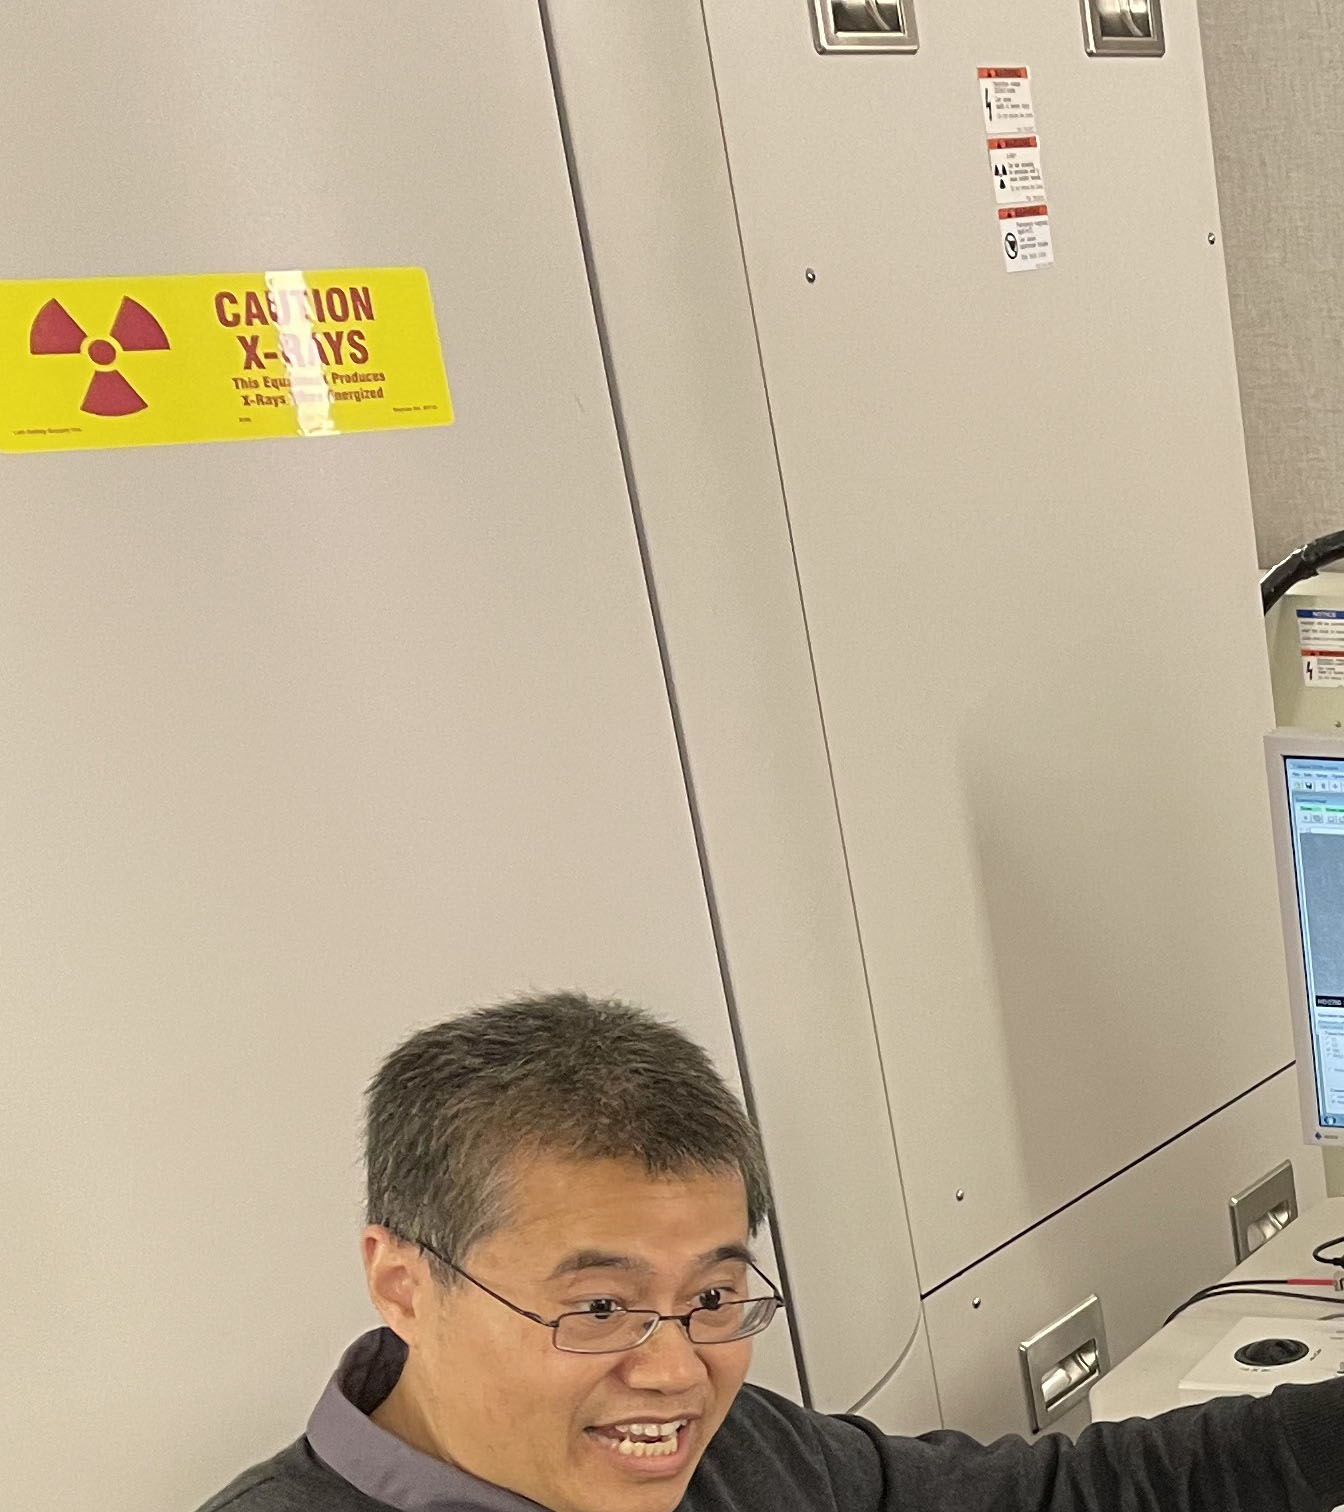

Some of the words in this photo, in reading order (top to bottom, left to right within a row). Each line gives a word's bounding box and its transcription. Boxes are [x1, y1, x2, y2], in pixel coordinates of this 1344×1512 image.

[232, 377, 259, 390] This
[332, 371, 386, 384] Produces
[241, 394, 286, 407] X-Rays
